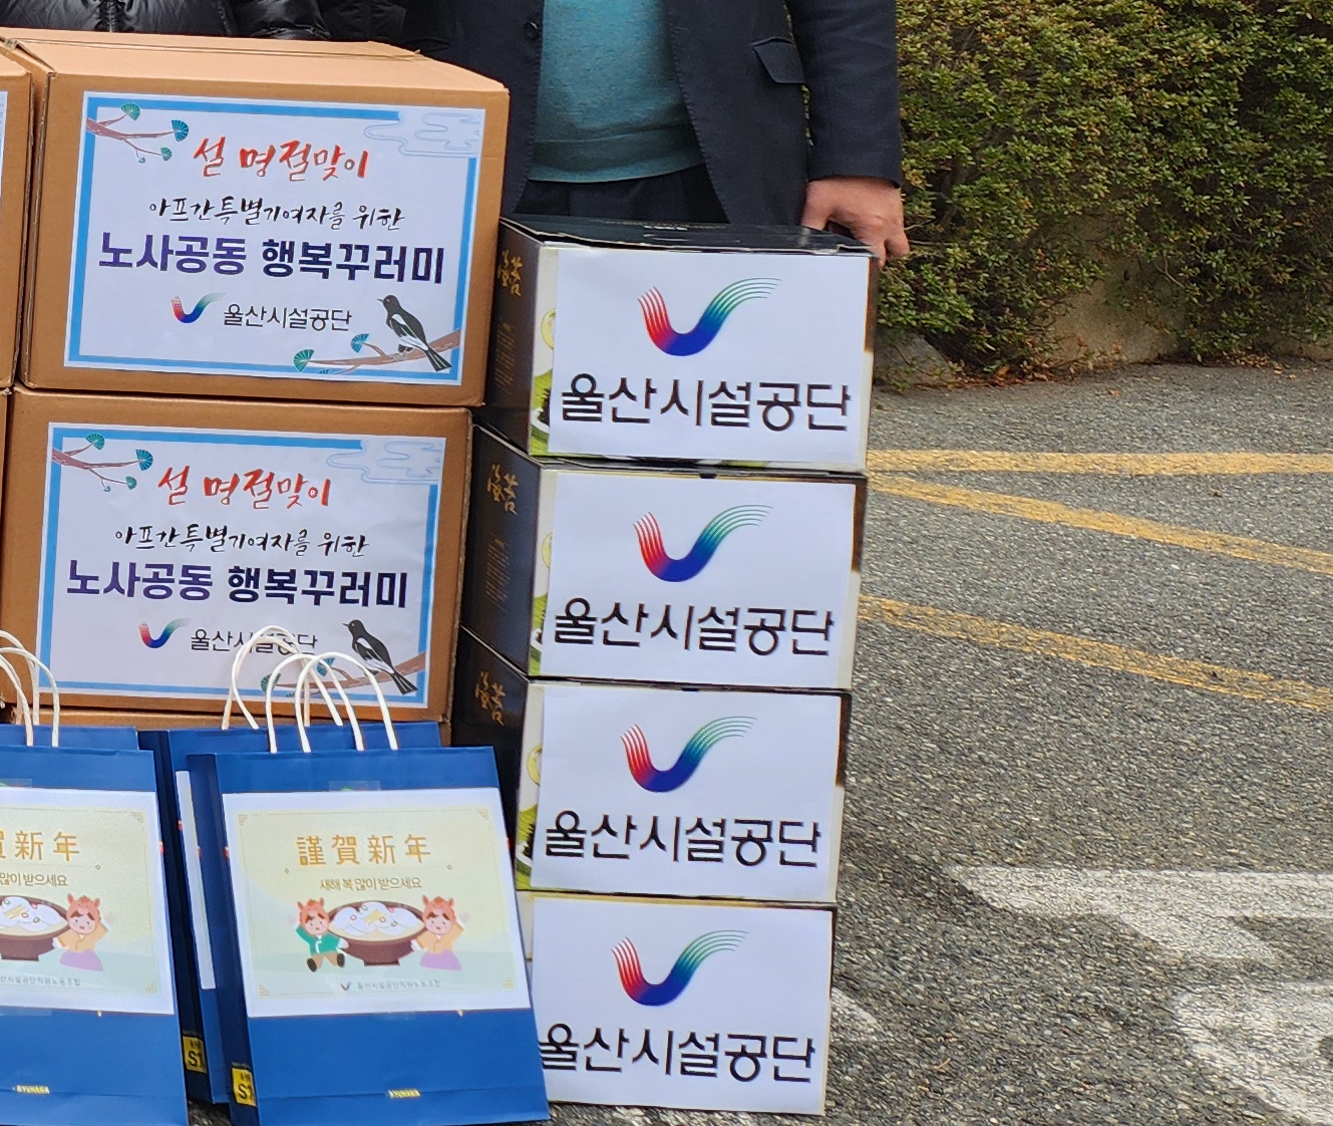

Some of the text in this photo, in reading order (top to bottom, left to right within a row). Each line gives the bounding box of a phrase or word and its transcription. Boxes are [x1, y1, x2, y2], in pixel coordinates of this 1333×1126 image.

[193, 136, 369, 182] 설 명절맞이
[149, 196, 405, 231] 아프간특별기여자를 위한
[98, 231, 444, 285] 노사공동 행복꾸러미
[223, 304, 352, 332] 울산시설공단
[561, 373, 851, 432] 울산시설공단
[157, 465, 331, 510] 설 명절맞이
[115, 523, 370, 558] 아프간특별기여자를 위한
[66, 559, 408, 609] 노사공동 행복꾸러미
[554, 598, 834, 656] 울산시설공단
[295, 833, 431, 866] 謹賀新年
[546, 810, 822, 868] 울산시설공단
[0, 872, 21, 886] 많이
[23, 873, 68, 887] 받으세요
[320, 877, 421, 891] 새해 복 많이 받으세요
[538, 1023, 815, 1083] 울산시설공단
